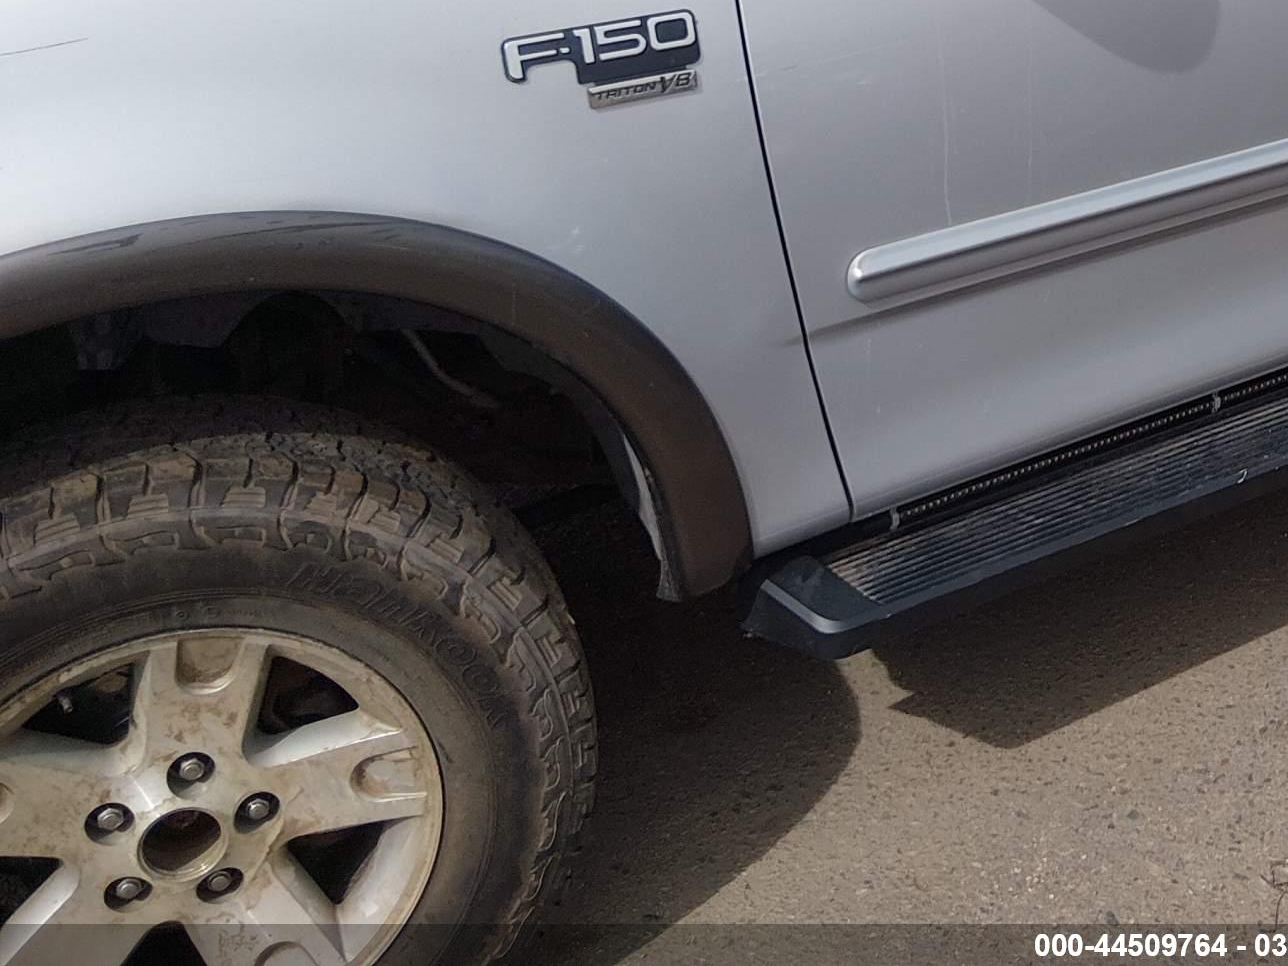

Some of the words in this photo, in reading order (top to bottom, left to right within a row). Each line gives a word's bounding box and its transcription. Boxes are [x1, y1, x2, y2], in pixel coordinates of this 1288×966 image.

[503, 10, 698, 80] F-150
[595, 83, 657, 101] TRITON
[658, 72, 693, 94] V8
